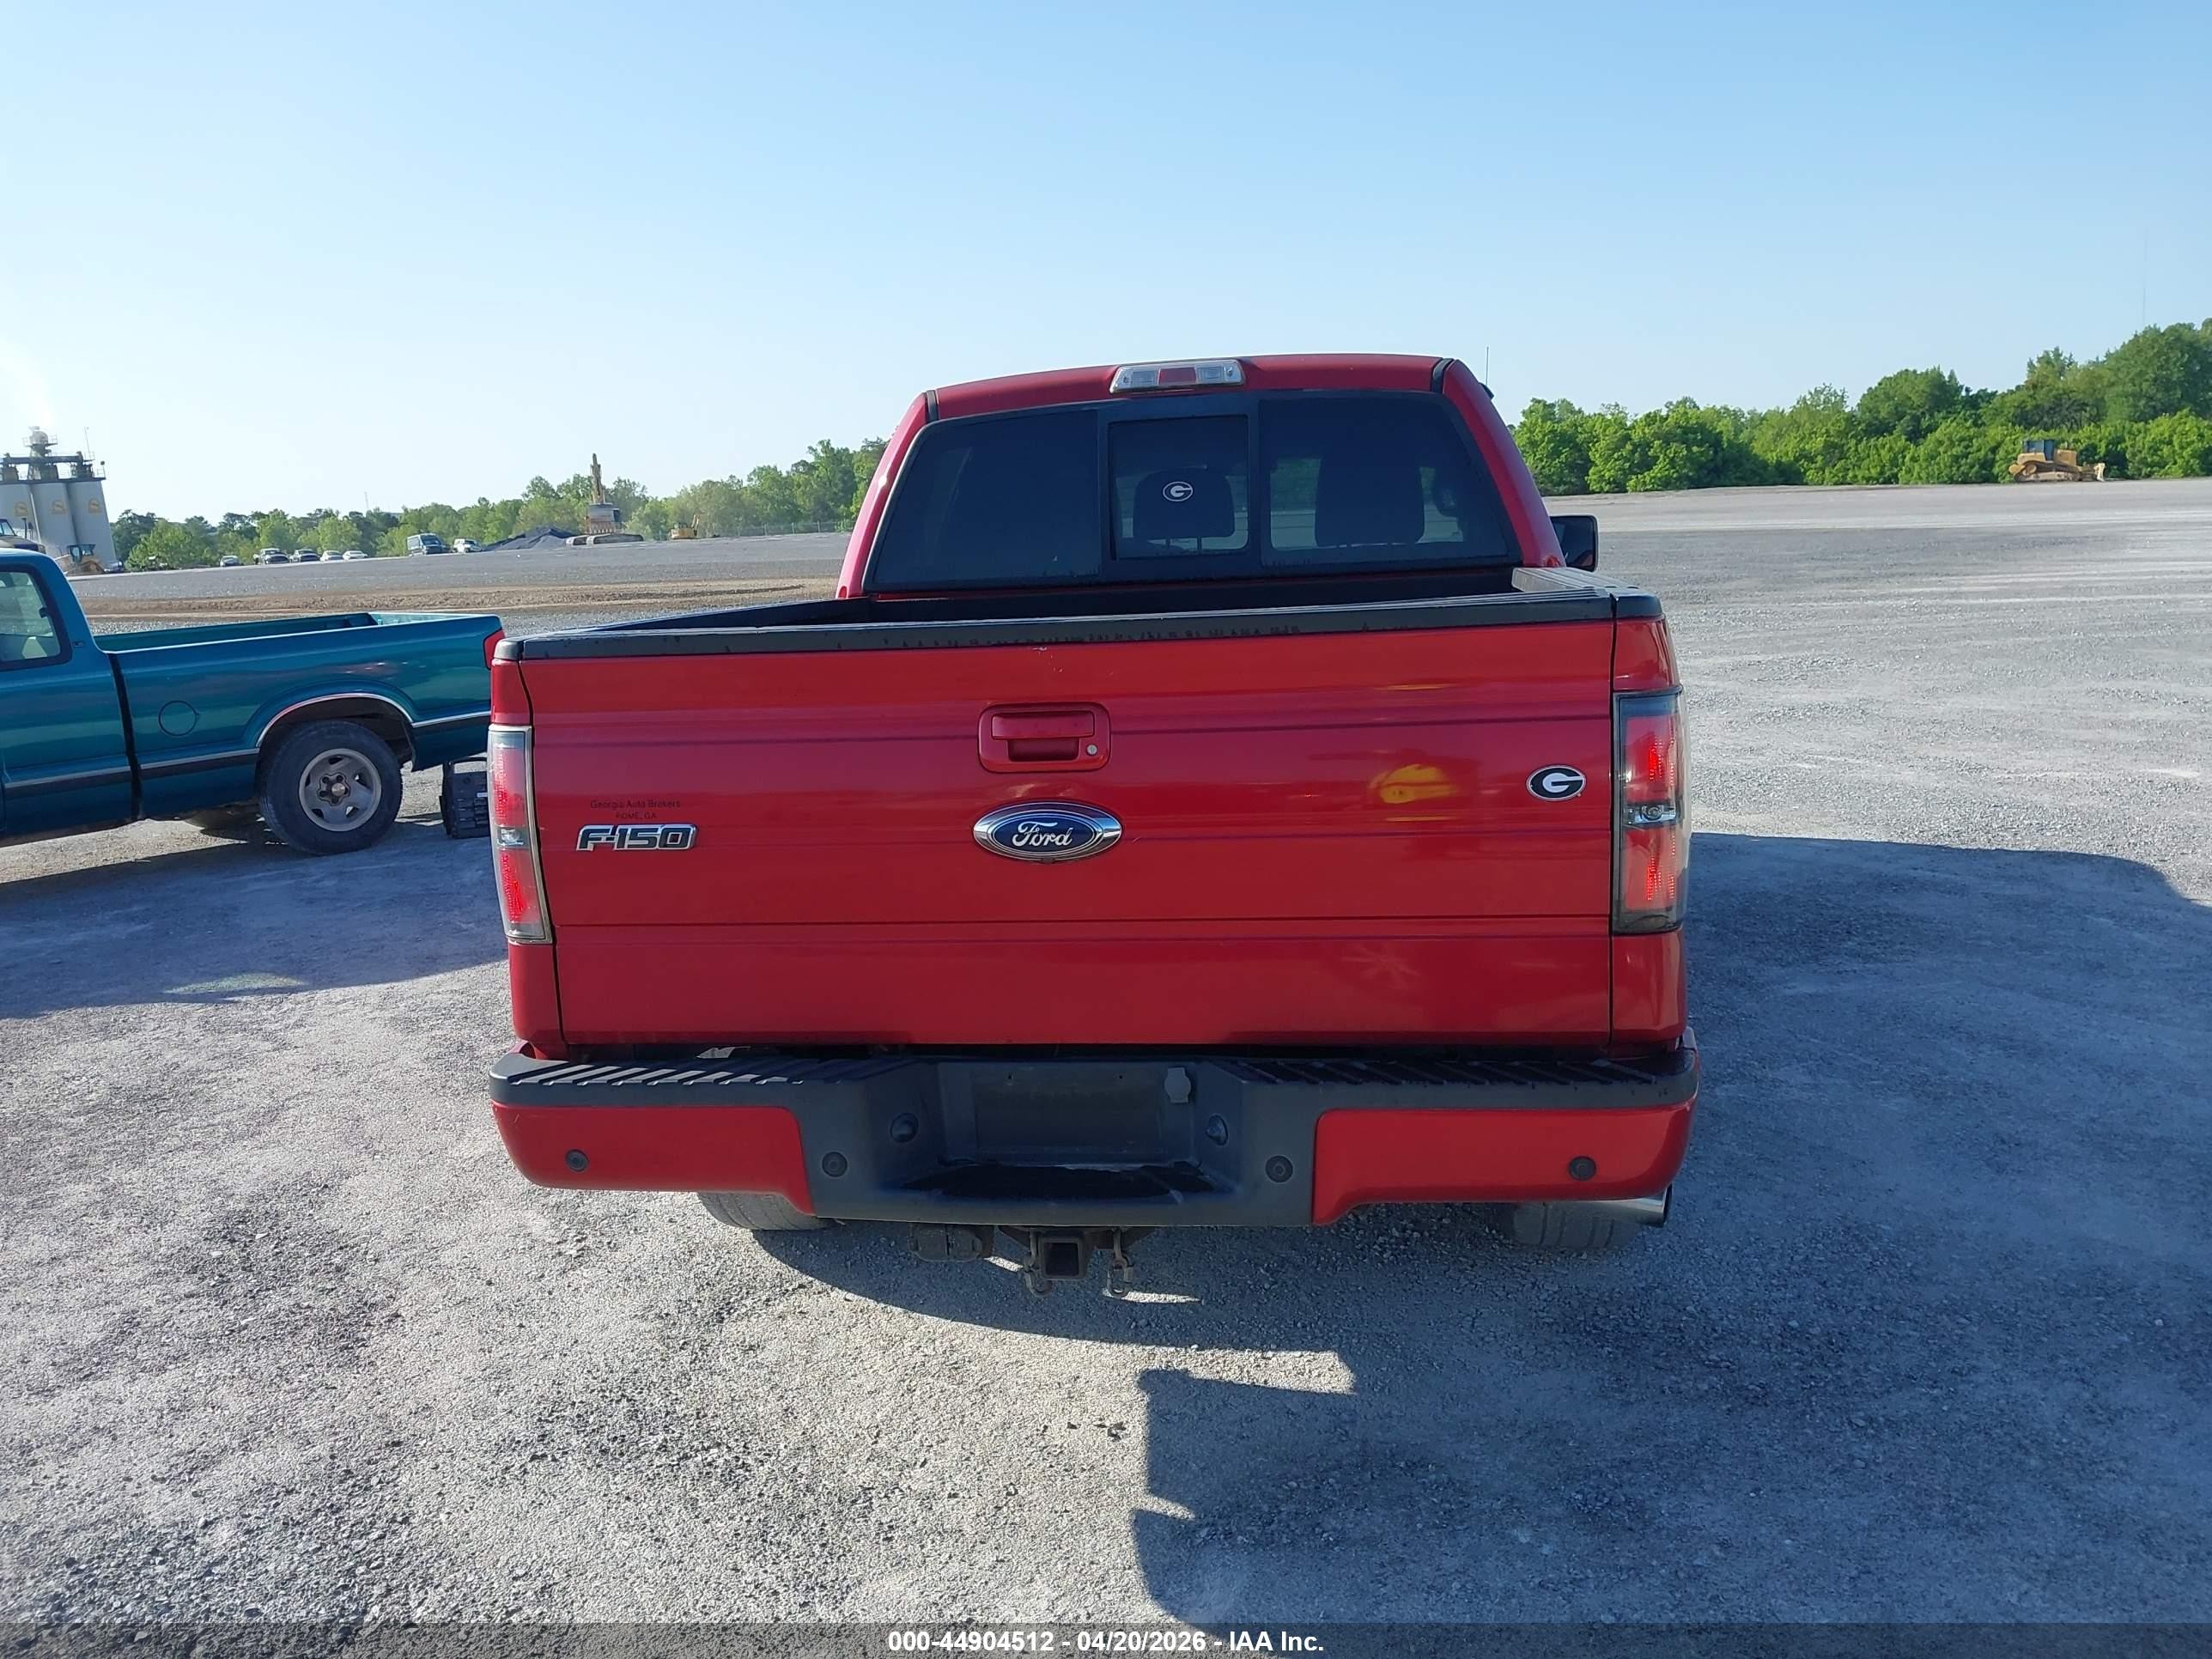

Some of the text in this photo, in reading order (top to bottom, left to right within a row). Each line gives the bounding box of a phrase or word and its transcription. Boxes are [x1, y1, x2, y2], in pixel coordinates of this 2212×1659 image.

[590, 799, 681, 810] Georgia Auto Brokers
[576, 824, 697, 851] F-150
[1012, 821, 1073, 847] Ford
